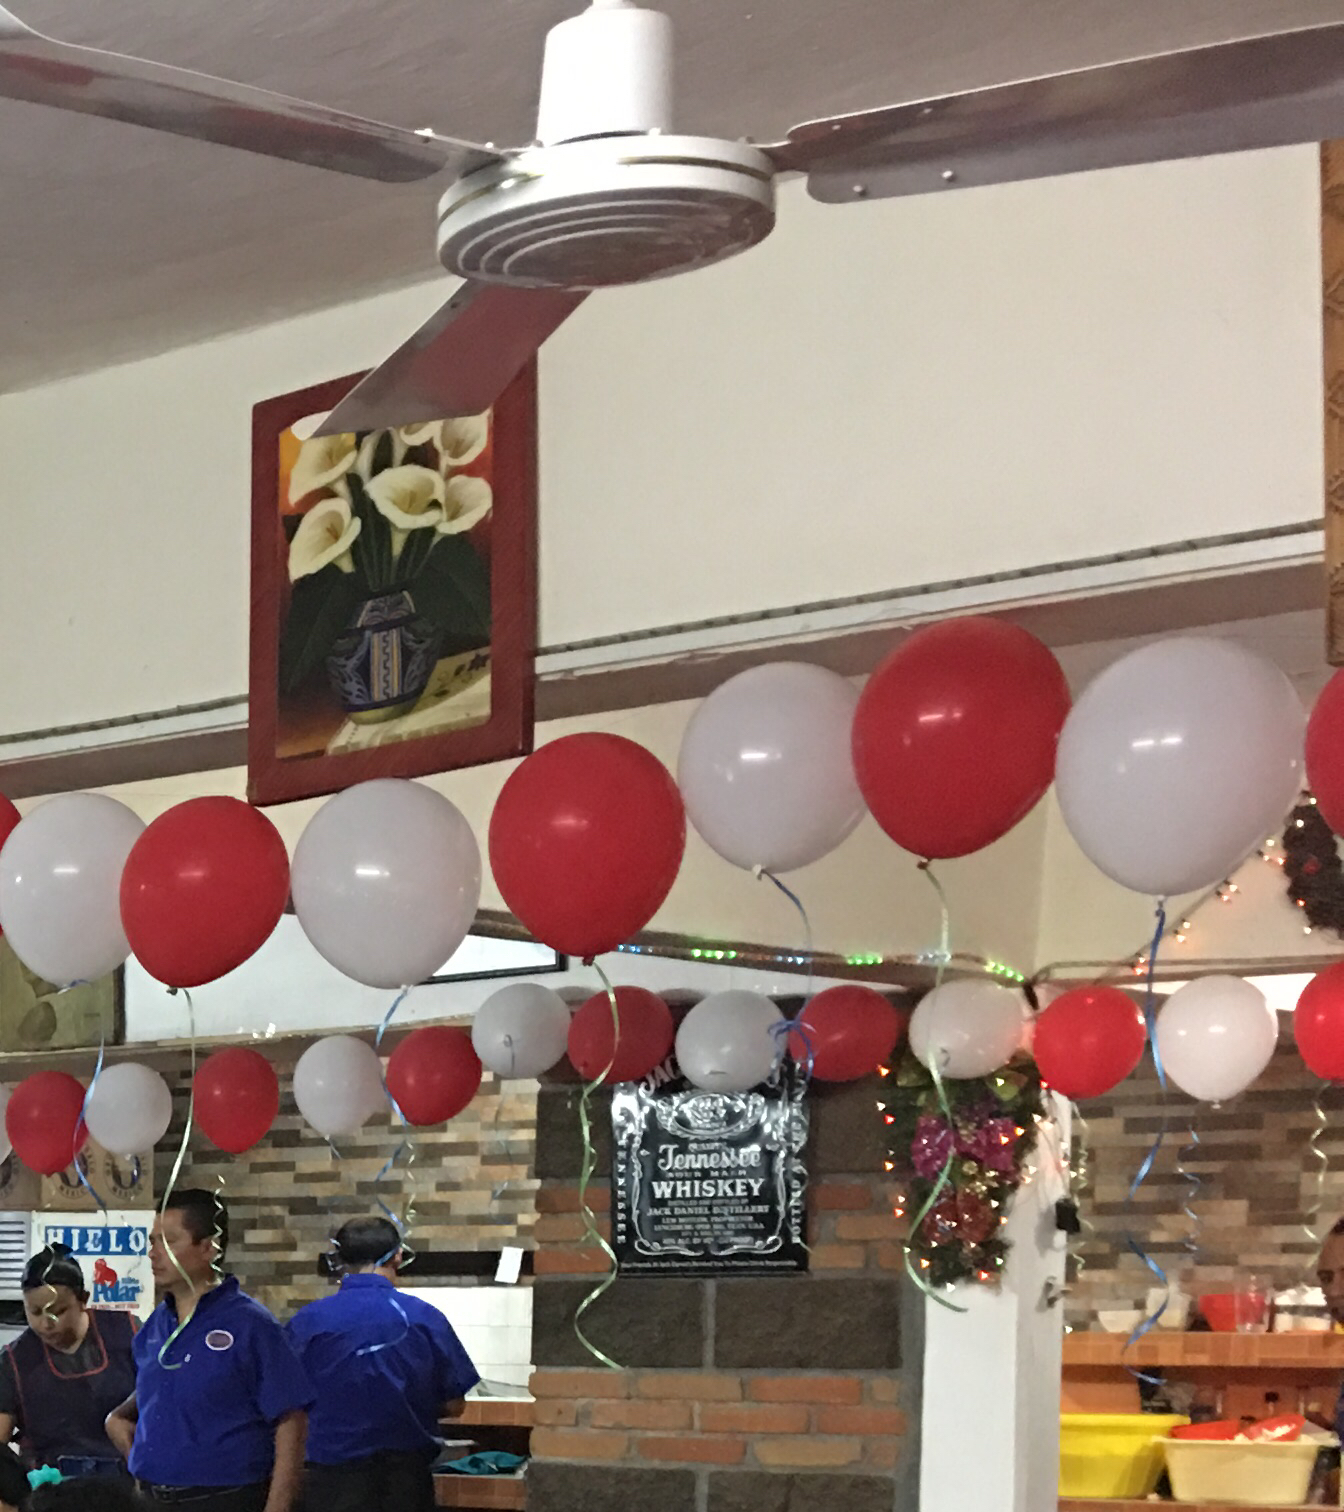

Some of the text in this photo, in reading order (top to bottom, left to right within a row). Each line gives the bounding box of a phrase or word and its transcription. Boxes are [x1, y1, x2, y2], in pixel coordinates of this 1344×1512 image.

[639, 1055, 681, 1098] JAC
[658, 1144, 762, 1171] Tennessee
[652, 1178, 765, 1199] WHISKEY
[46, 1228, 146, 1252] HIELO
[92, 1280, 141, 1302] Polar
